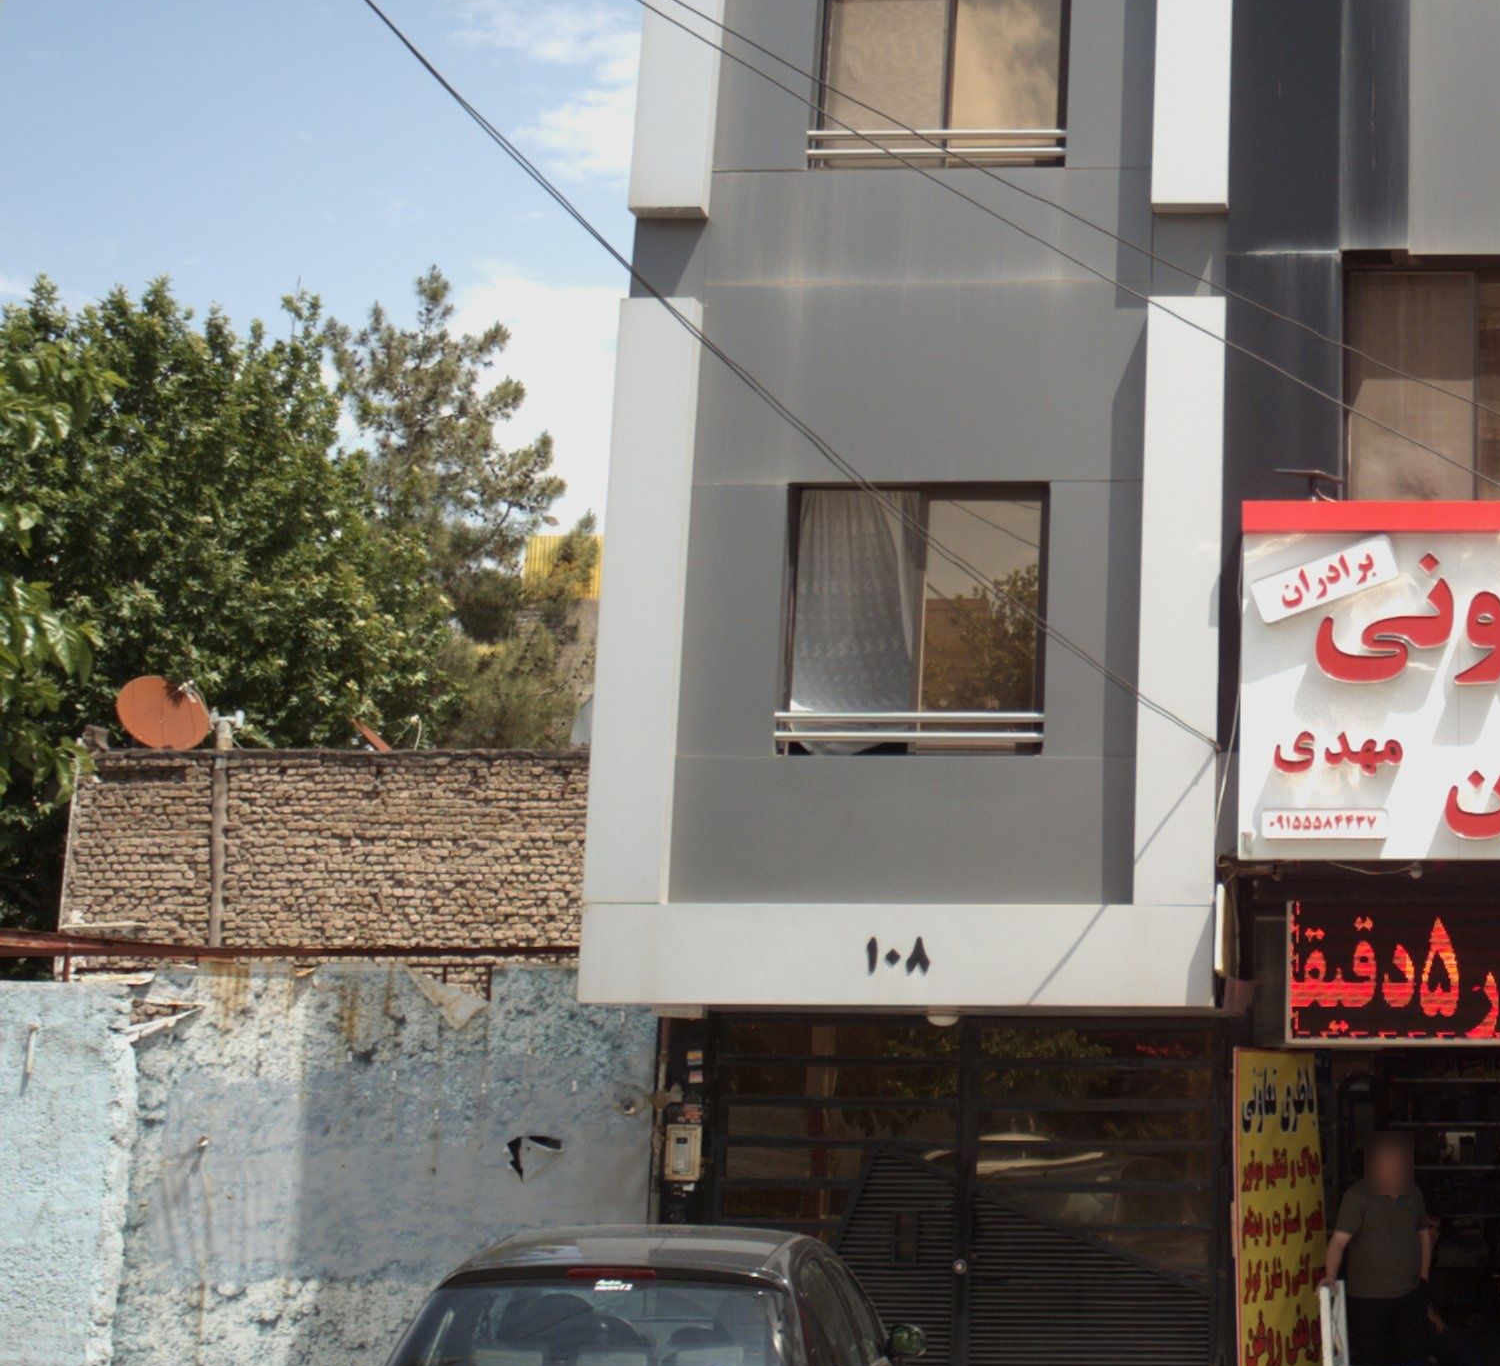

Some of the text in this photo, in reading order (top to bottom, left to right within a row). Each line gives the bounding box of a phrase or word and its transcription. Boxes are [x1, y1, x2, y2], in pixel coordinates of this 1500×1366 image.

[1281, 552, 1376, 610] برادران
[1273, 731, 1404, 777] مهدی
[865, 935, 931, 975] ۱۰۸
[1290, 915, 1415, 1033] دقیق
[1419, 916, 1460, 1018] ۵
